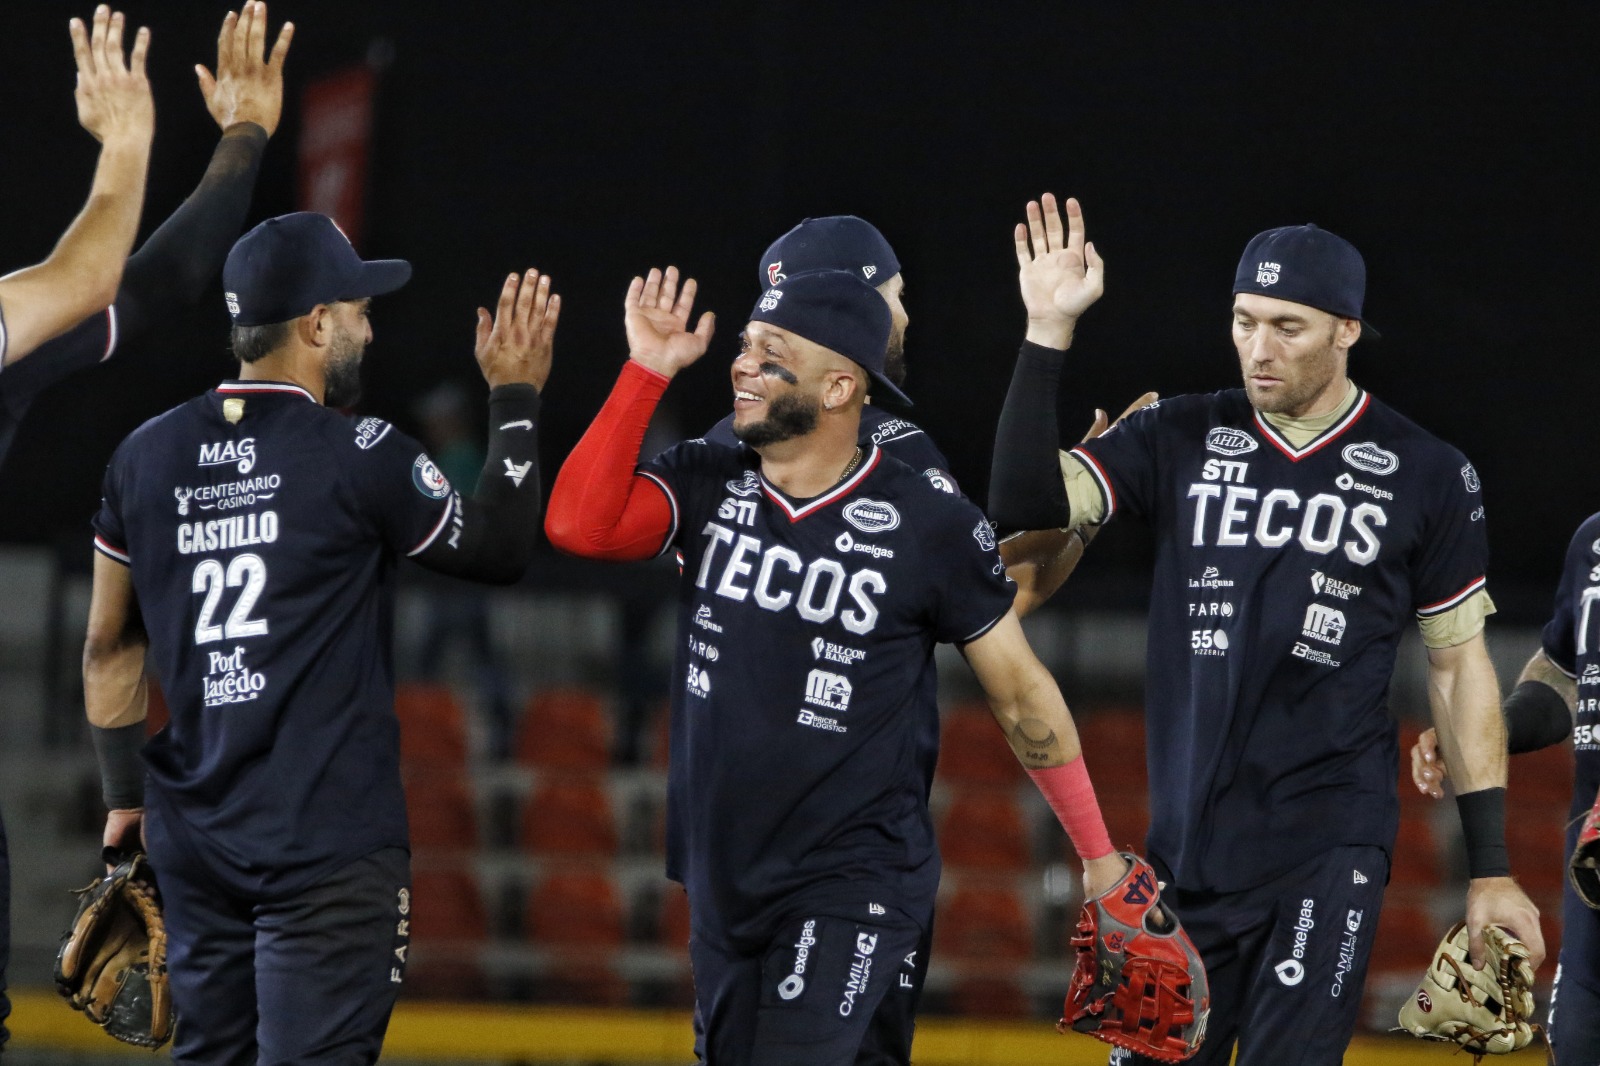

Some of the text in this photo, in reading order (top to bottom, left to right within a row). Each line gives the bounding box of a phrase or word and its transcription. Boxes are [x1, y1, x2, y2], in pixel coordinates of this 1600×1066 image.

[1258, 262, 1281, 273] LMB
[1255, 270, 1279, 284] 100
[1211, 434, 1247, 448] AHIA
[199, 438, 256, 474] MAG
[1353, 450, 1389, 466] PANAMEX
[1202, 459, 1249, 484] STI
[194, 474, 281, 501] CENTENARIO
[1354, 482, 1394, 501] exelgas
[217, 493, 256, 510] CASINO
[718, 497, 758, 526] STI
[853, 509, 889, 522] PANAMEX
[177, 511, 279, 554] CASTILLO
[1187, 483, 1388, 567] TECOS
[853, 542, 894, 559] exelgas
[695, 521, 887, 635] TECOS
[1189, 578, 1234, 589] La Laguna
[1325, 578, 1362, 596] FALCON
[192, 553, 269, 645] 22
[1324, 586, 1349, 600] BANK
[695, 614, 723, 633] Laguna
[1302, 630, 1340, 645] MONALAR
[209, 645, 245, 674] Port
[825, 652, 852, 665] BANK
[826, 643, 866, 660] FALCON
[1306, 654, 1341, 667] LOGISTICS
[805, 695, 847, 711] MONALAR
[812, 721, 848, 733] LOGISTICS
[813, 716, 837, 726] BRICER
[1123, 871, 1155, 904] 44
[390, 887, 410, 983] FARO
[1293, 899, 1314, 959] exelgas
[795, 920, 816, 974] exelgas
[859, 958, 872, 993] GRUPO
